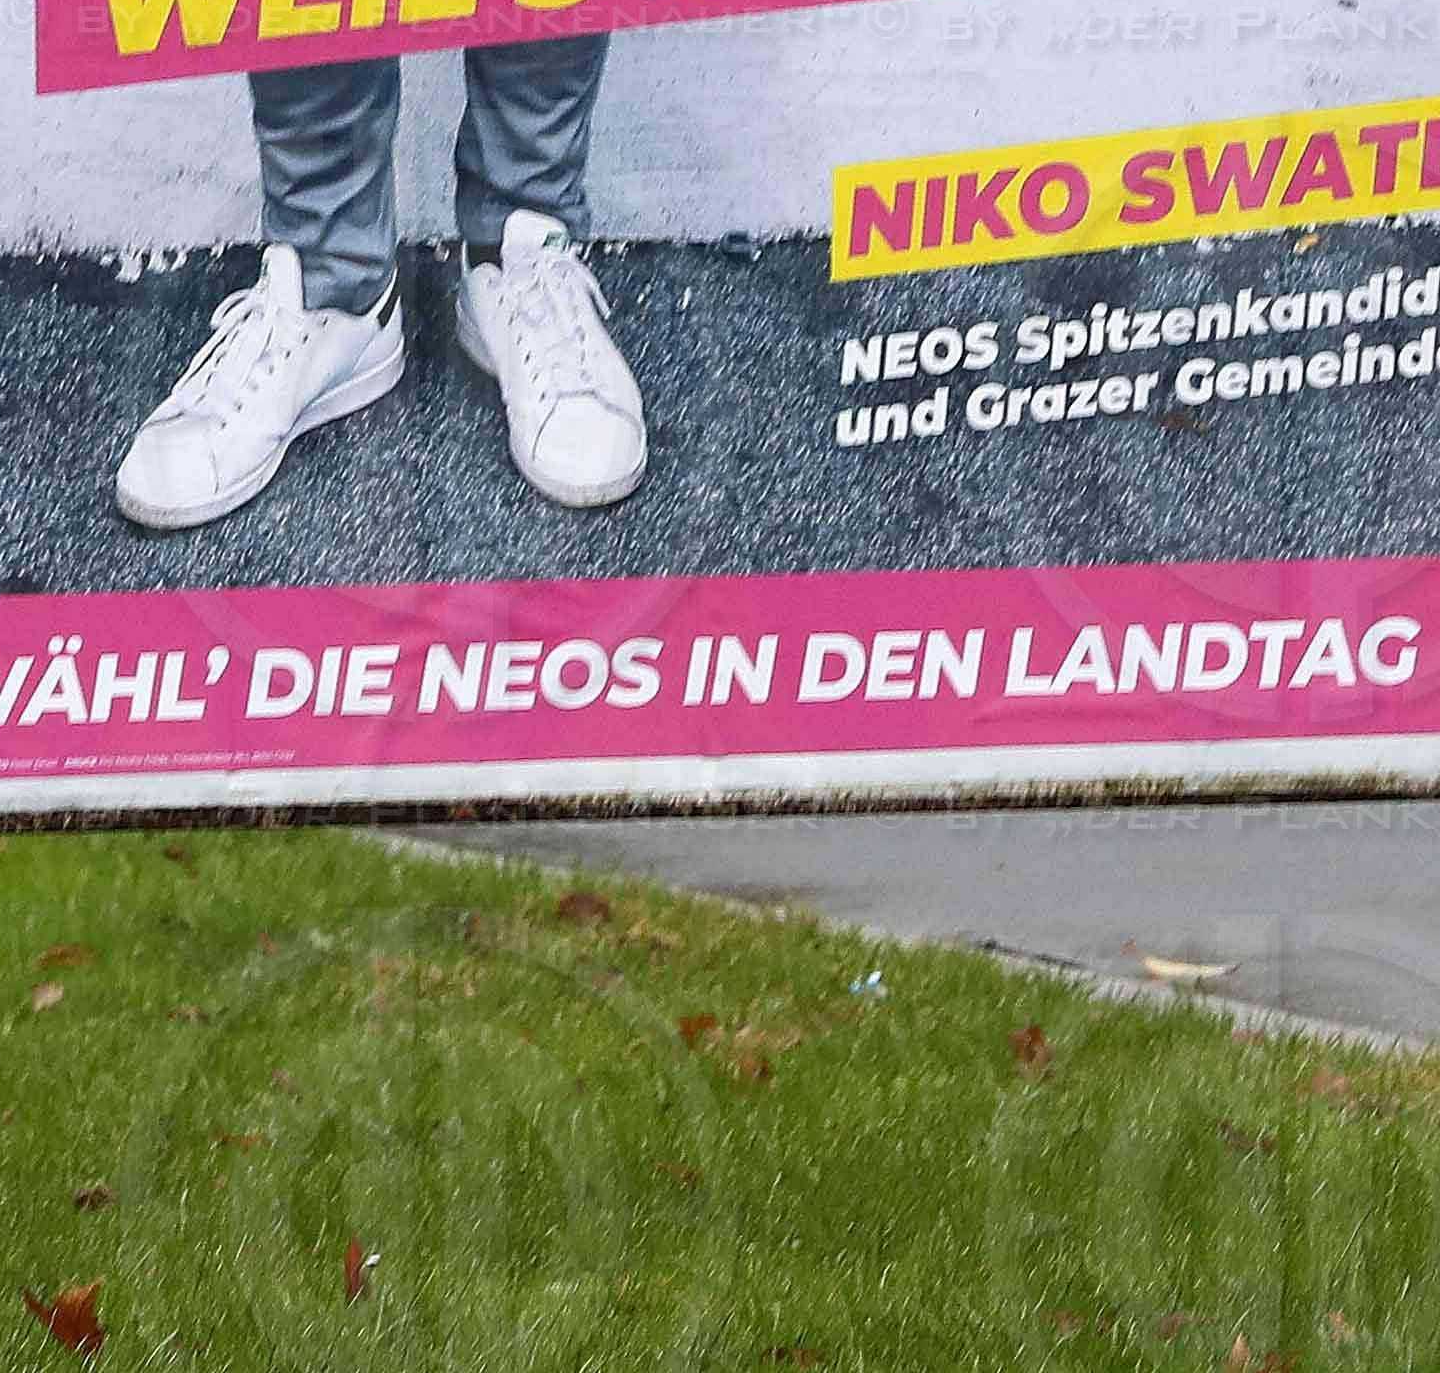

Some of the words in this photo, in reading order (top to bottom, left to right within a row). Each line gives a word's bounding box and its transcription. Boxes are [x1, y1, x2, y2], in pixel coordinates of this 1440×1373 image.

[847, 160, 1089, 259] NIKO
[839, 319, 1000, 387] NEOS
[834, 387, 949, 450] und
[965, 368, 1158, 431] Grazer
[245, 643, 401, 719] DIE
[417, 636, 665, 714] NEOS
[681, 633, 798, 707] IN
[797, 627, 986, 704] DEN
[1002, 615, 1423, 699] LANDTAG
